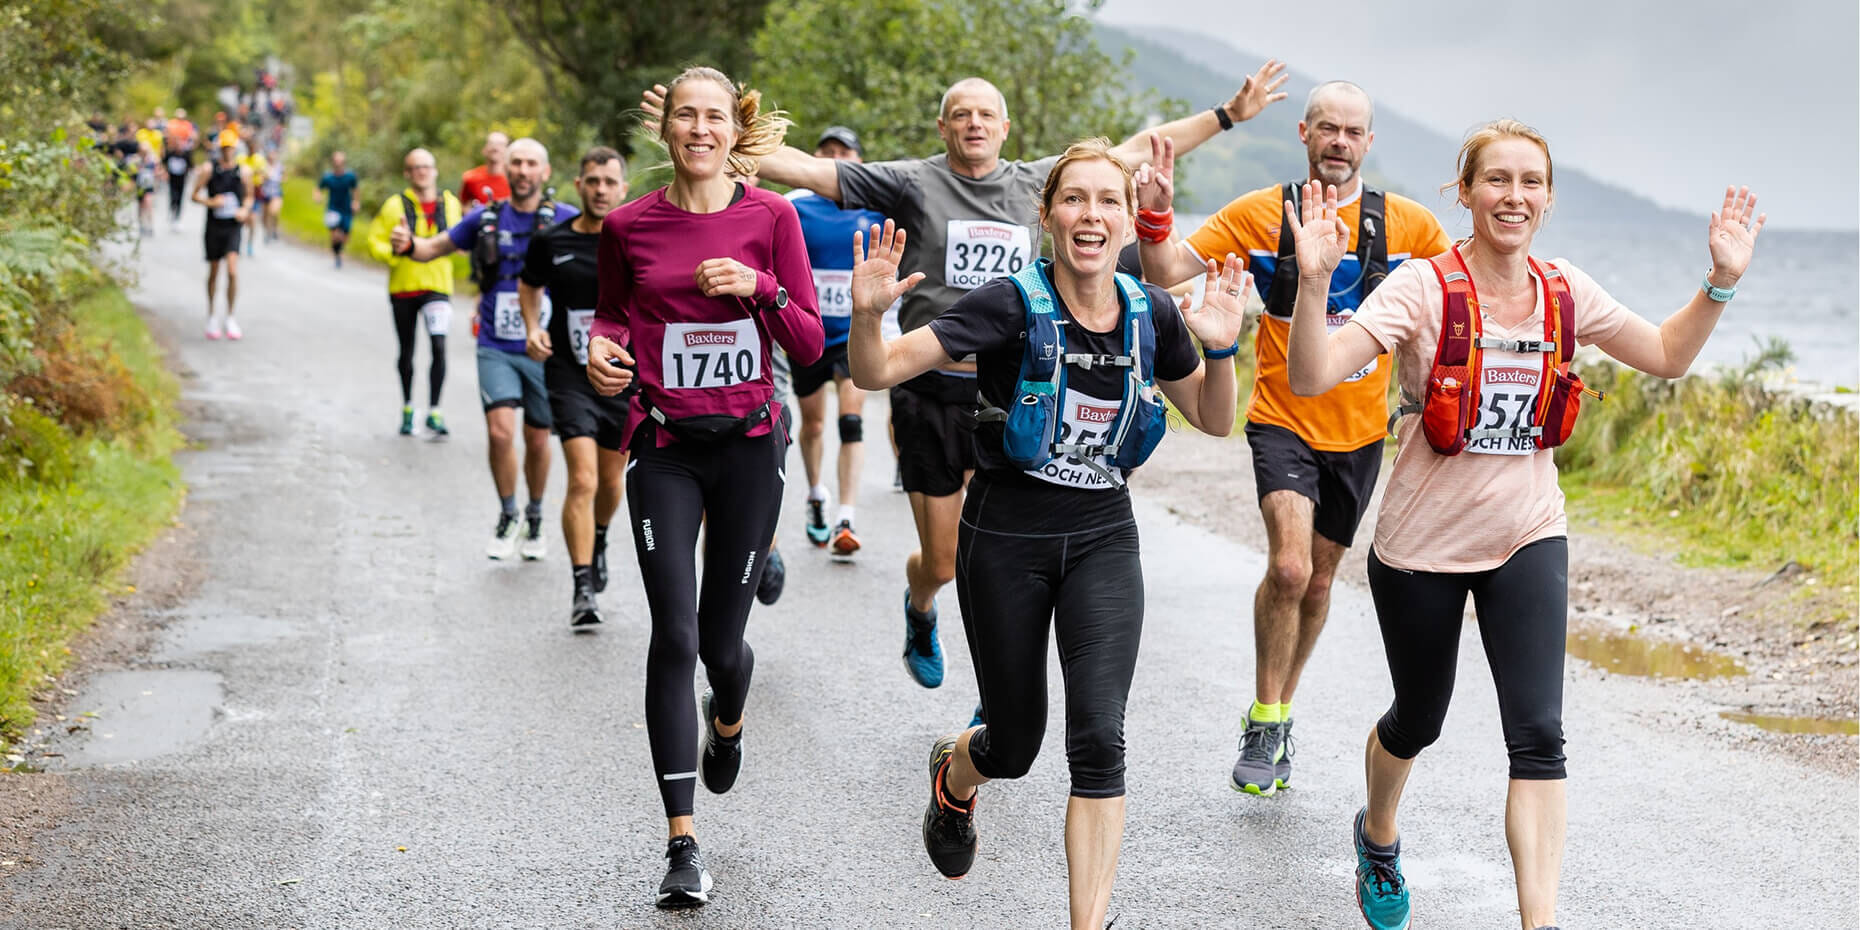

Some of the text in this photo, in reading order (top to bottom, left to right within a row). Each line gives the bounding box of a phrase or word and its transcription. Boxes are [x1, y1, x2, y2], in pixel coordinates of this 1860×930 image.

[953, 242, 1023, 274] 3226
[953, 274, 986, 286] LOCH
[686, 331, 735, 346] Baxters
[672, 349, 754, 387] 1740
[1487, 369, 1537, 385] Baxters
[1079, 407, 1117, 422] Baxt
[1507, 437, 1536, 451] NES
[1040, 463, 1082, 484] OCH
[642, 518, 656, 551] FUSION
[741, 551, 757, 584] FUSION
